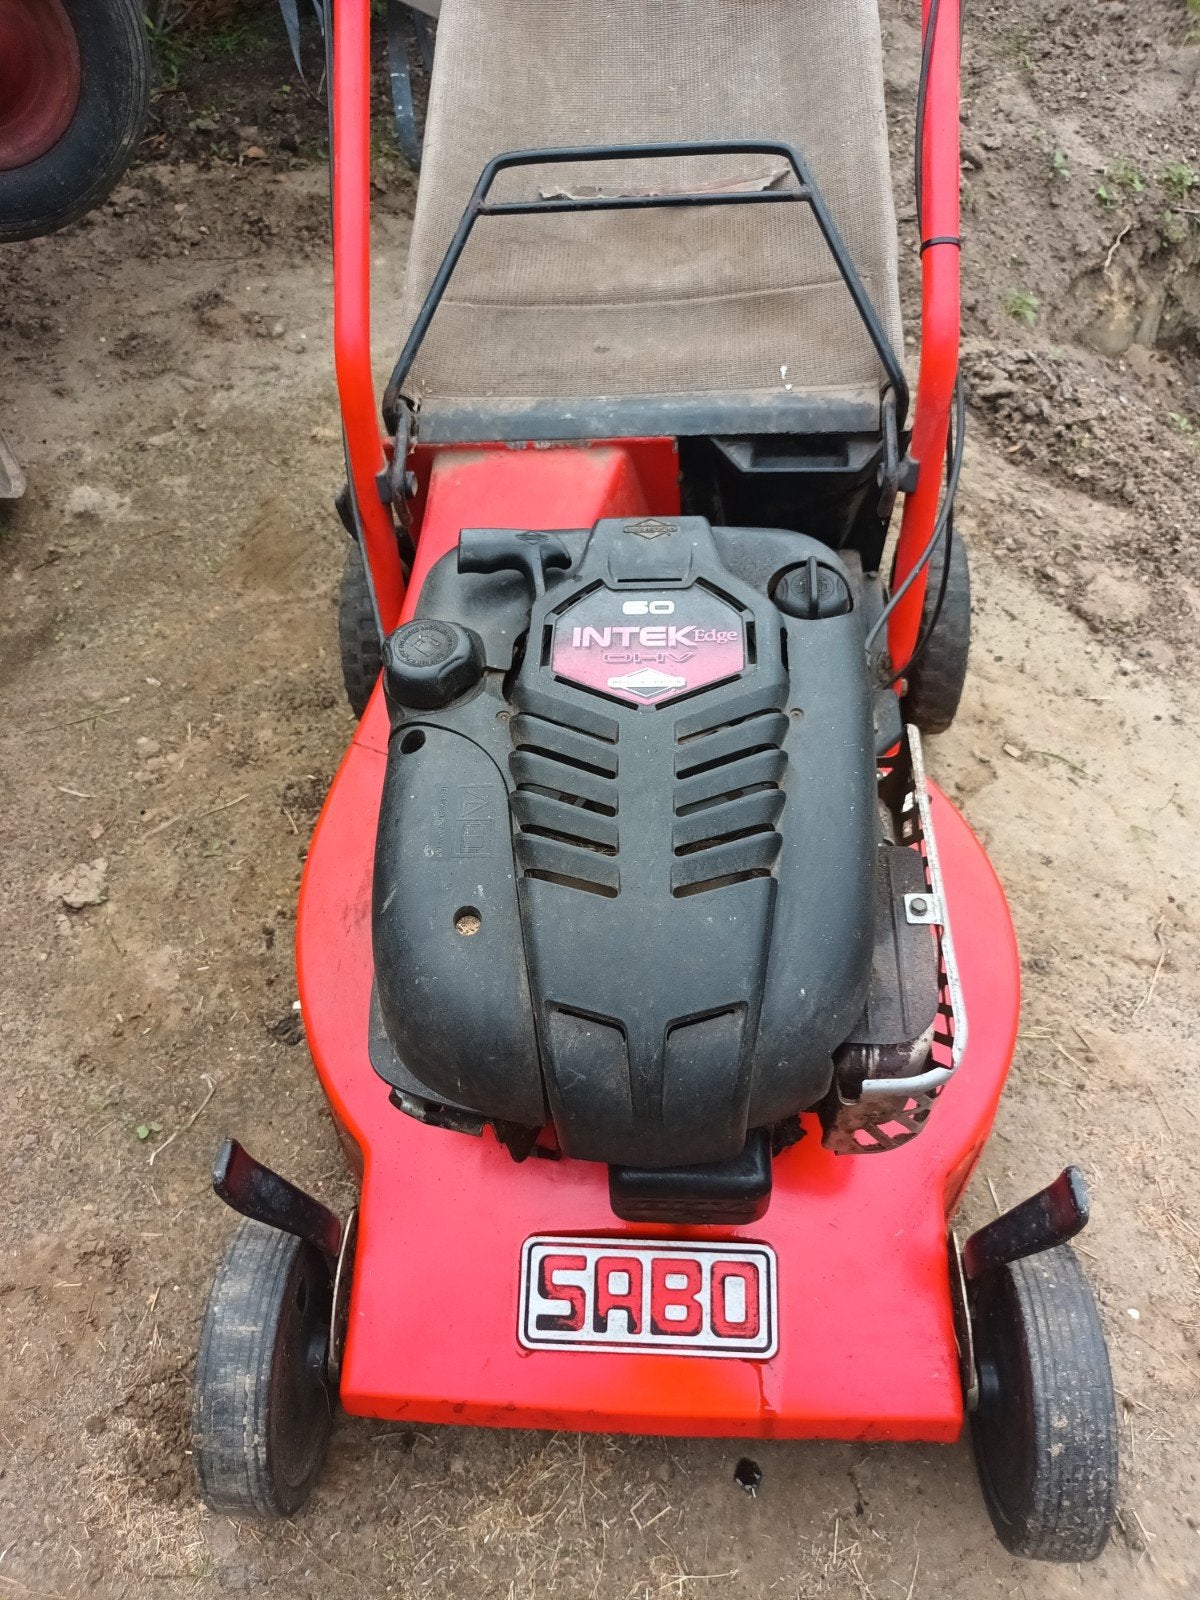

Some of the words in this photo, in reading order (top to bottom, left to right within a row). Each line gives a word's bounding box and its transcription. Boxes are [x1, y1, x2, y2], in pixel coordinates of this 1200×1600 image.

[622, 600, 675, 615] 60
[572, 626, 697, 647] INTEK
[694, 629, 738, 643] Edge
[603, 652, 696, 664] OHV
[536, 1254, 760, 1339] SABO
